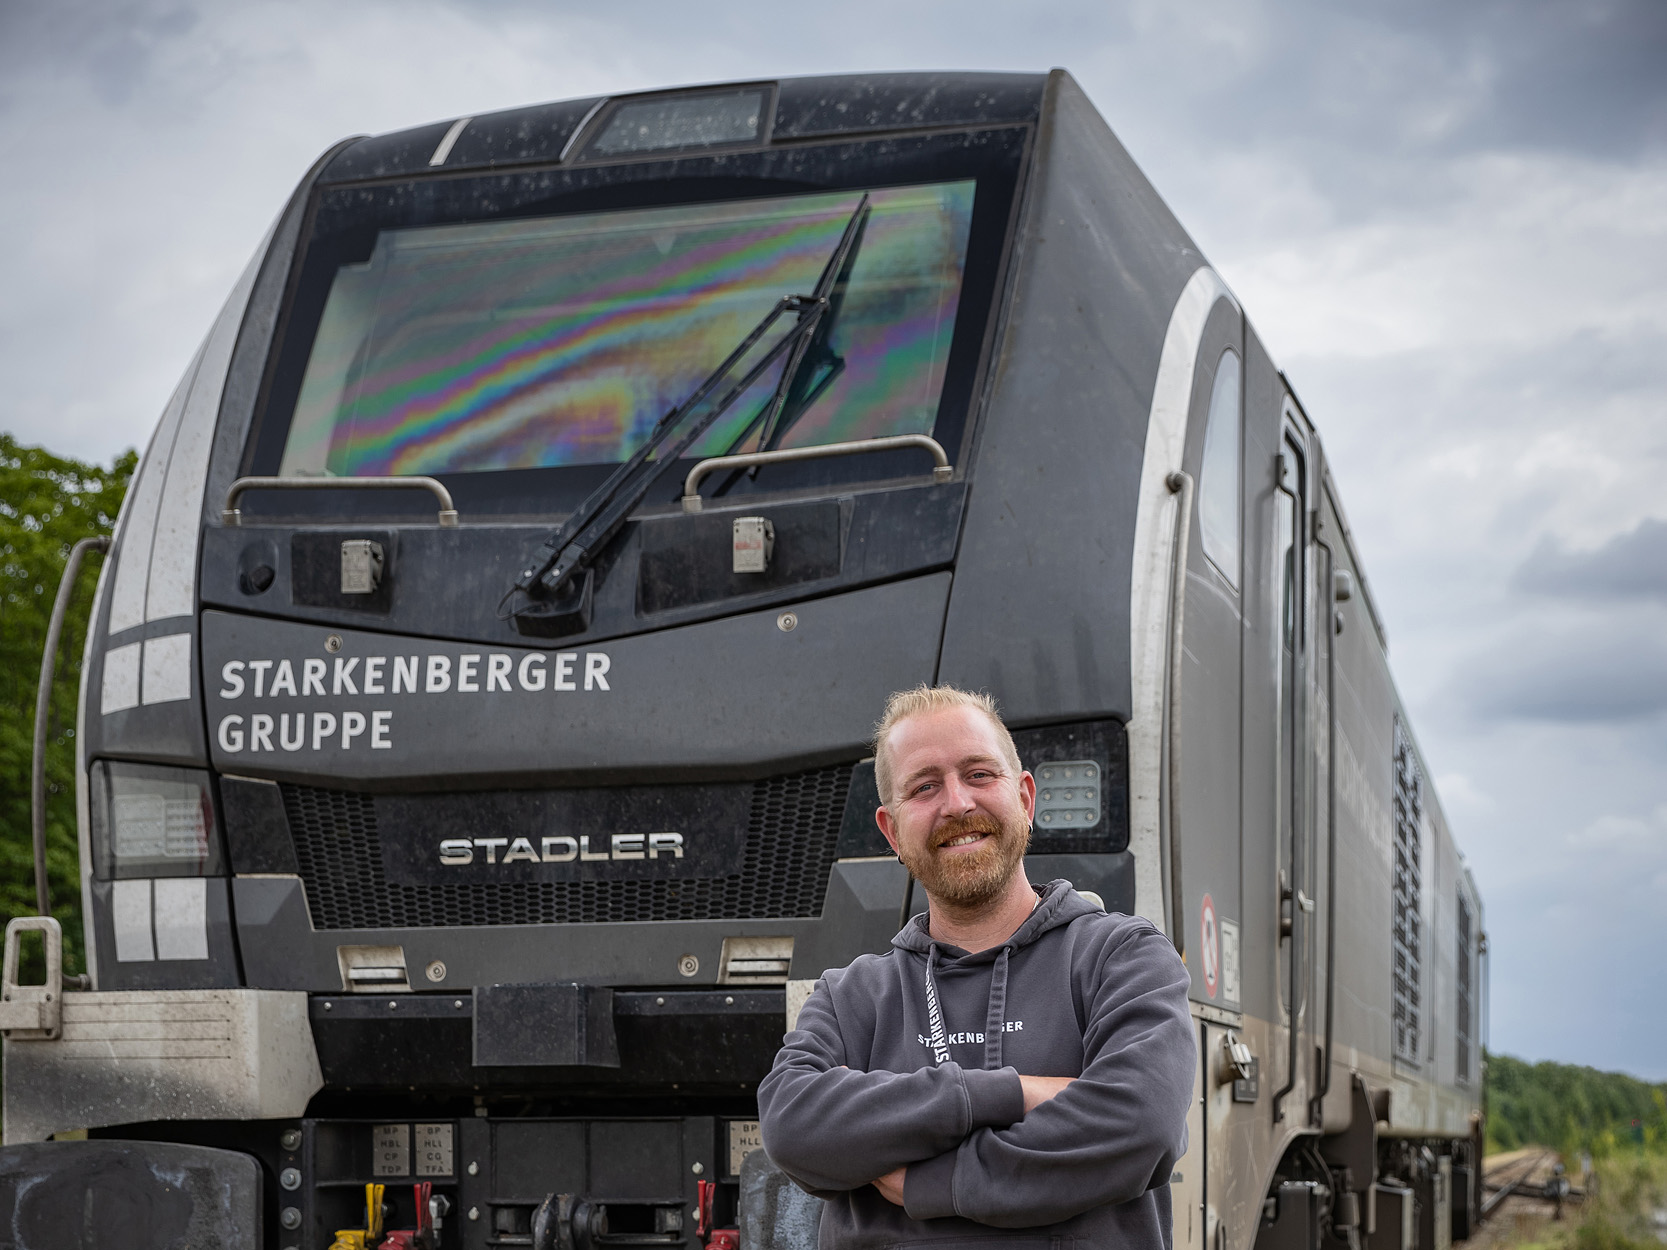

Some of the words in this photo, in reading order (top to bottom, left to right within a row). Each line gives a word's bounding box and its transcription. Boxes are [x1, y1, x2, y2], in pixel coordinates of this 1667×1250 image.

[219, 651, 612, 699] STARKENBERGER
[217, 710, 394, 753] GRUPPE
[438, 832, 685, 866] STADLER
[739, 1137, 760, 1147] HLL
[743, 1124, 757, 1132] BP
